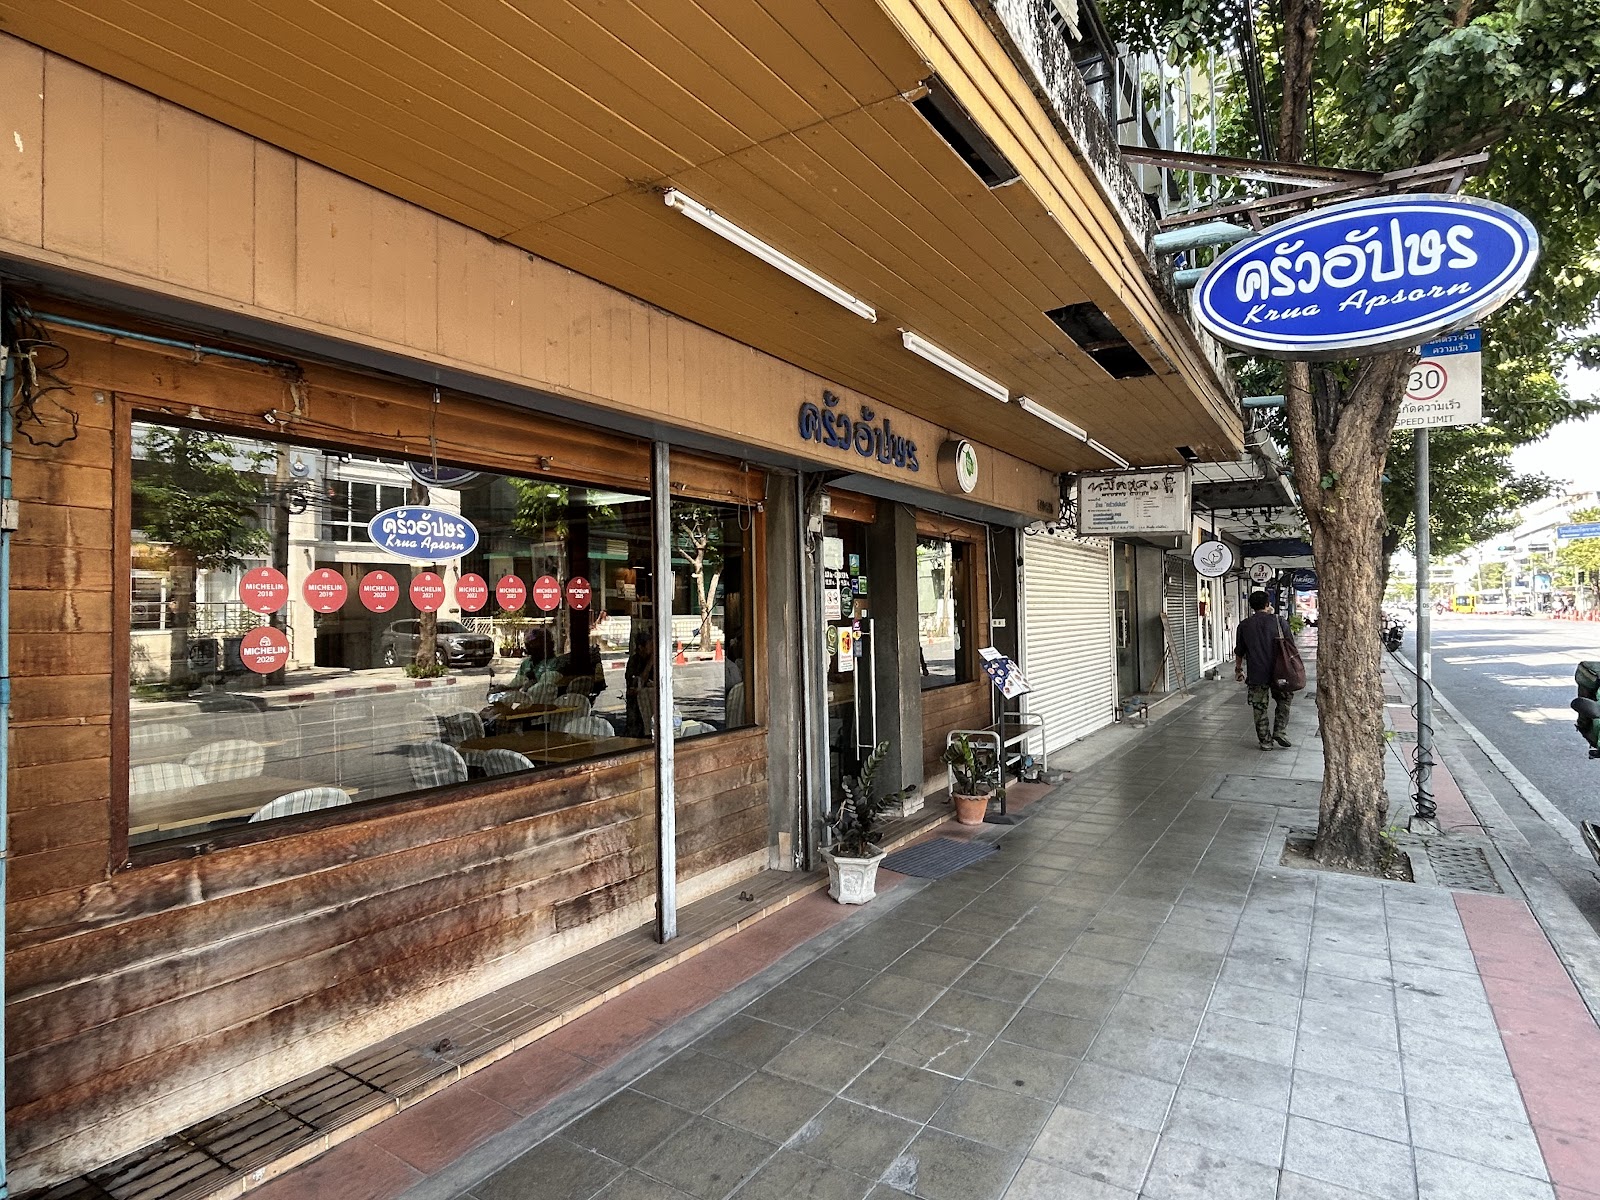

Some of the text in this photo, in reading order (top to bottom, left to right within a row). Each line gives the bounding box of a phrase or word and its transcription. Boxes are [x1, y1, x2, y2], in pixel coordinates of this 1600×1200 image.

[1235, 217, 1479, 302] ครัวอัปษร
[1242, 279, 1472, 325] Krua Apsorn
[1432, 342, 1469, 354] ความเร็ว
[1408, 370, 1441, 391] 30
[1395, 414, 1455, 427] SPEED LIMIT
[798, 389, 919, 473] ครัวอัปษร
[382, 510, 466, 538] ครัวอัปษร
[385, 533, 465, 553] Krua Apsorn
[243, 646, 287, 655] MICHELIN
[256, 656, 275, 664] 2026
